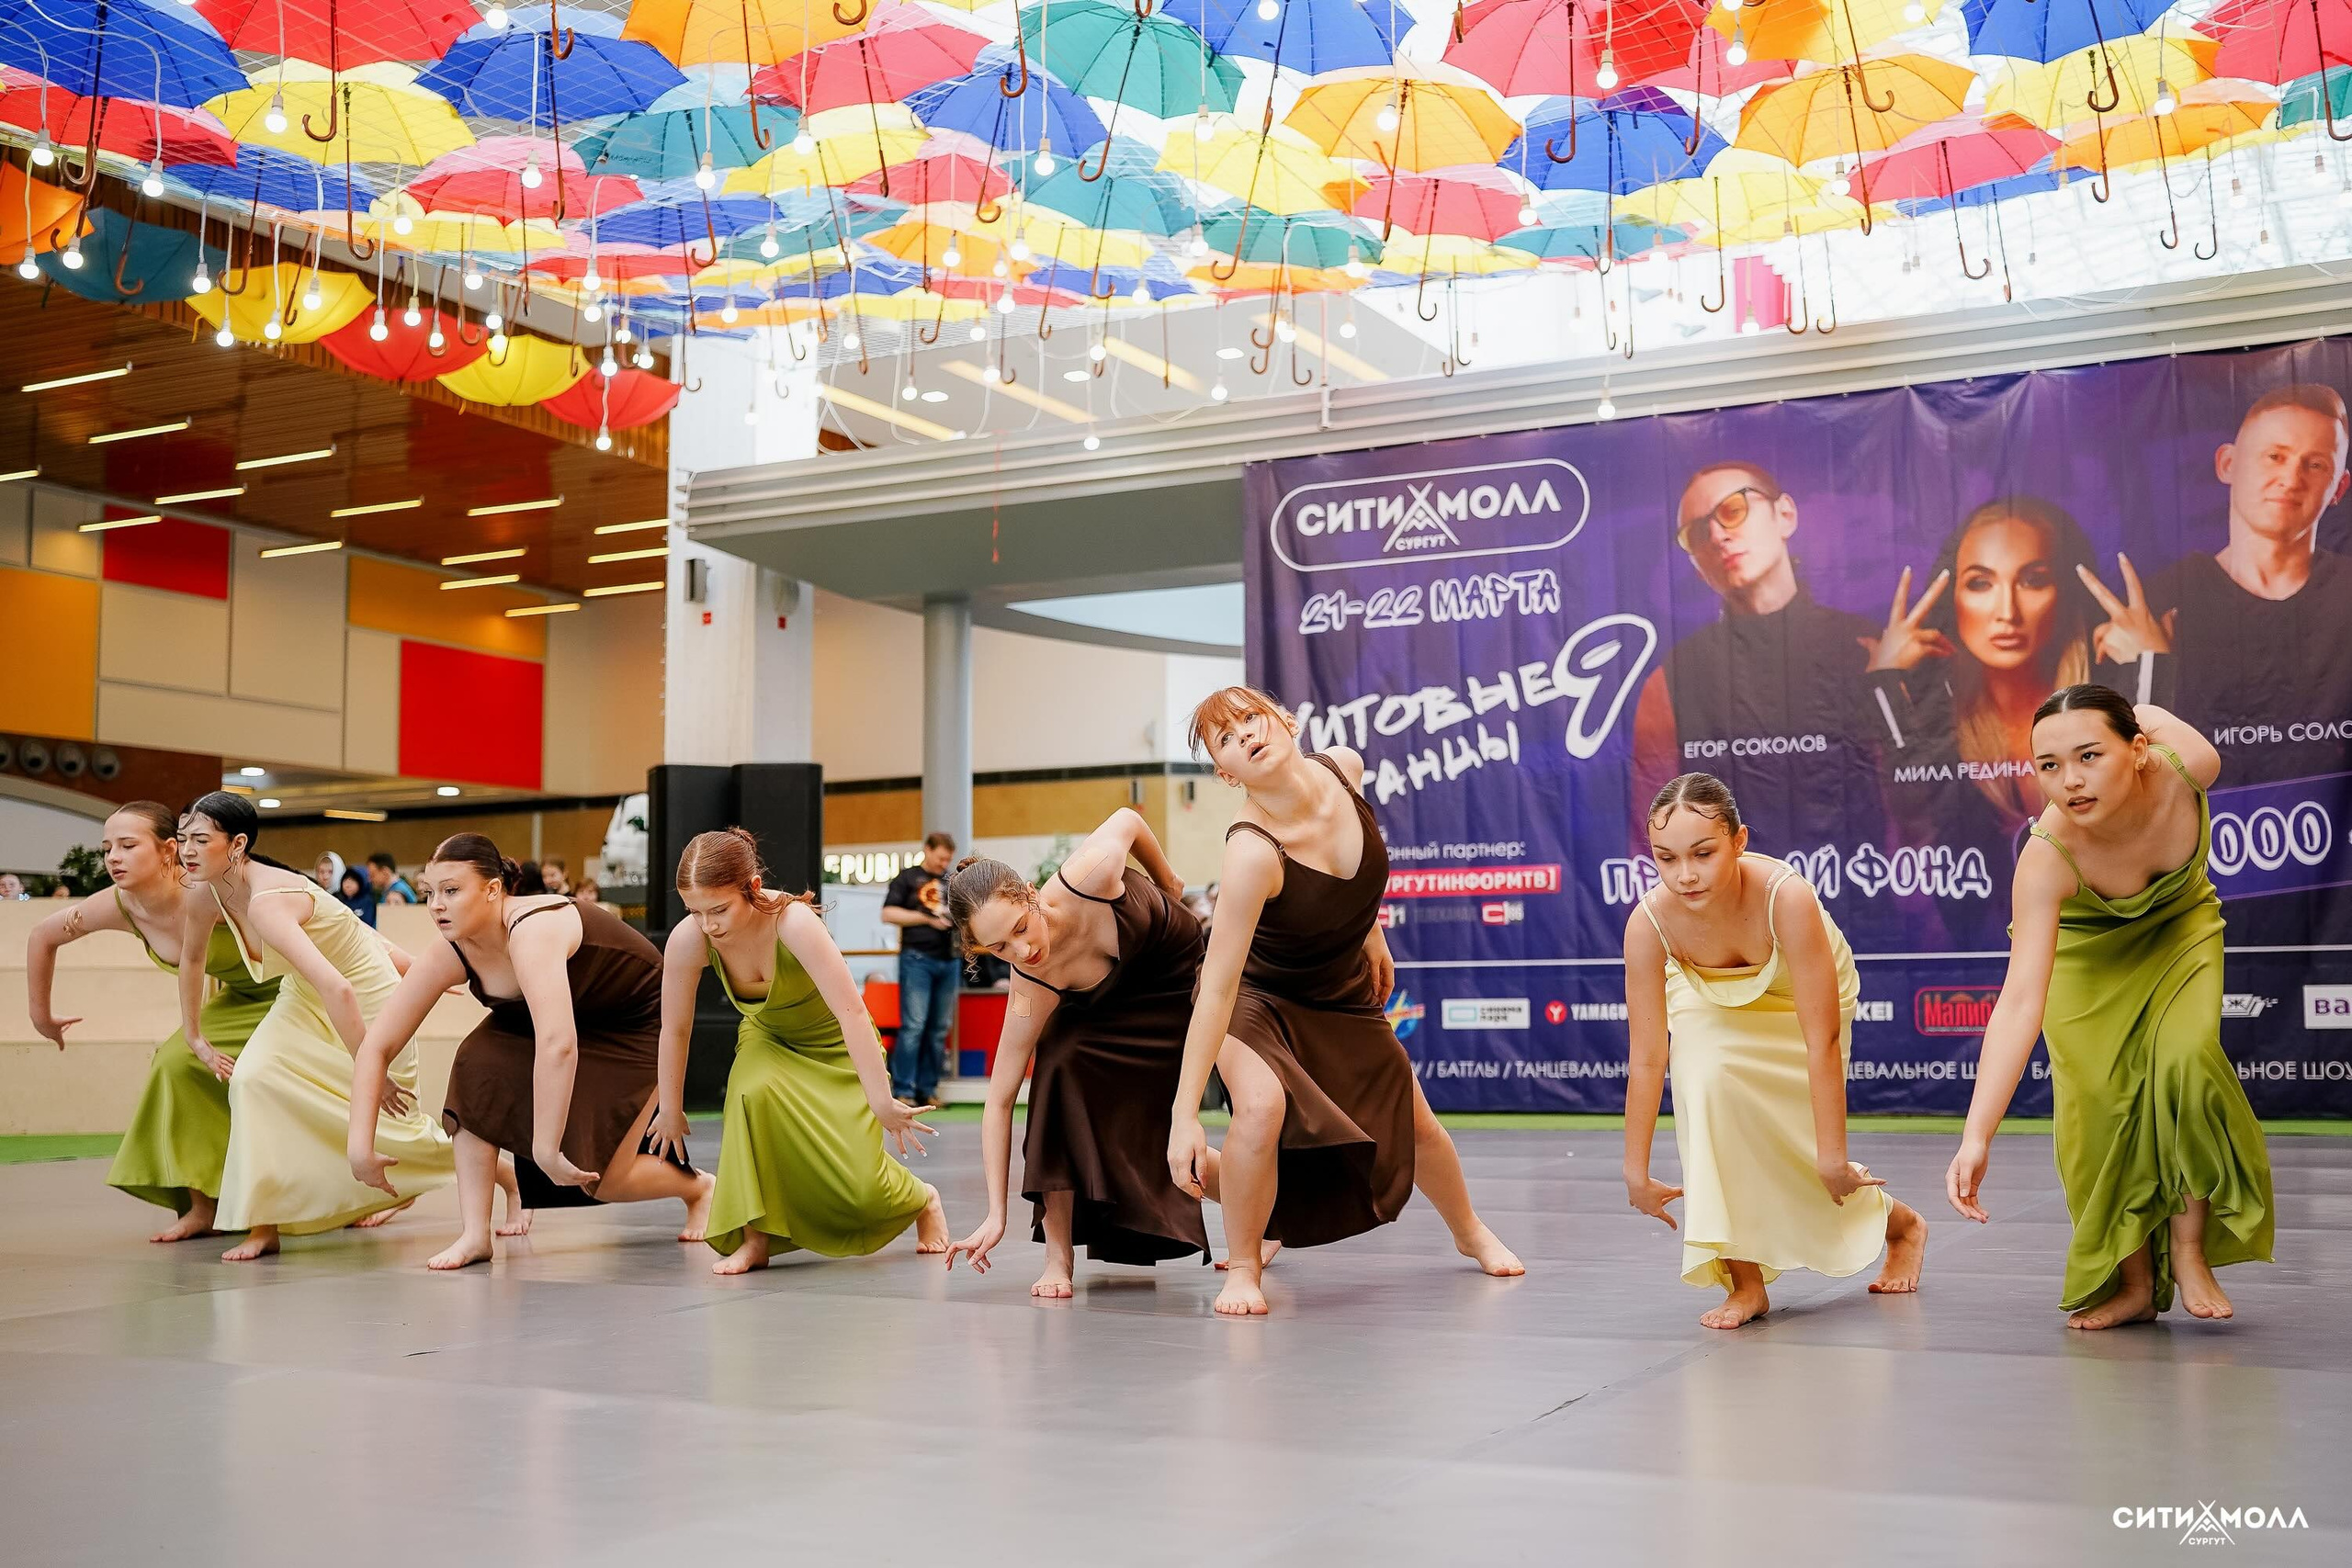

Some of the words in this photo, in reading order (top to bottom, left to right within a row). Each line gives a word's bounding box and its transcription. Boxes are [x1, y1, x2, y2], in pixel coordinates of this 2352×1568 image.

[1395, 533, 1448, 551] СУРГУТ
[1298, 585, 1425, 635] 21-22
[1430, 568, 1561, 623] МАРТА
[1684, 738, 1728, 759] ЕГОР
[1731, 734, 1828, 757] СОКОЛОВ
[2214, 725, 2283, 746] ИГОРЬ
[1894, 763, 1953, 783] МИЛА
[1957, 759, 2036, 781] РЕДИНА
[1442, 840, 1527, 862] партнер:
[1845, 842, 1993, 899] ФОНД
